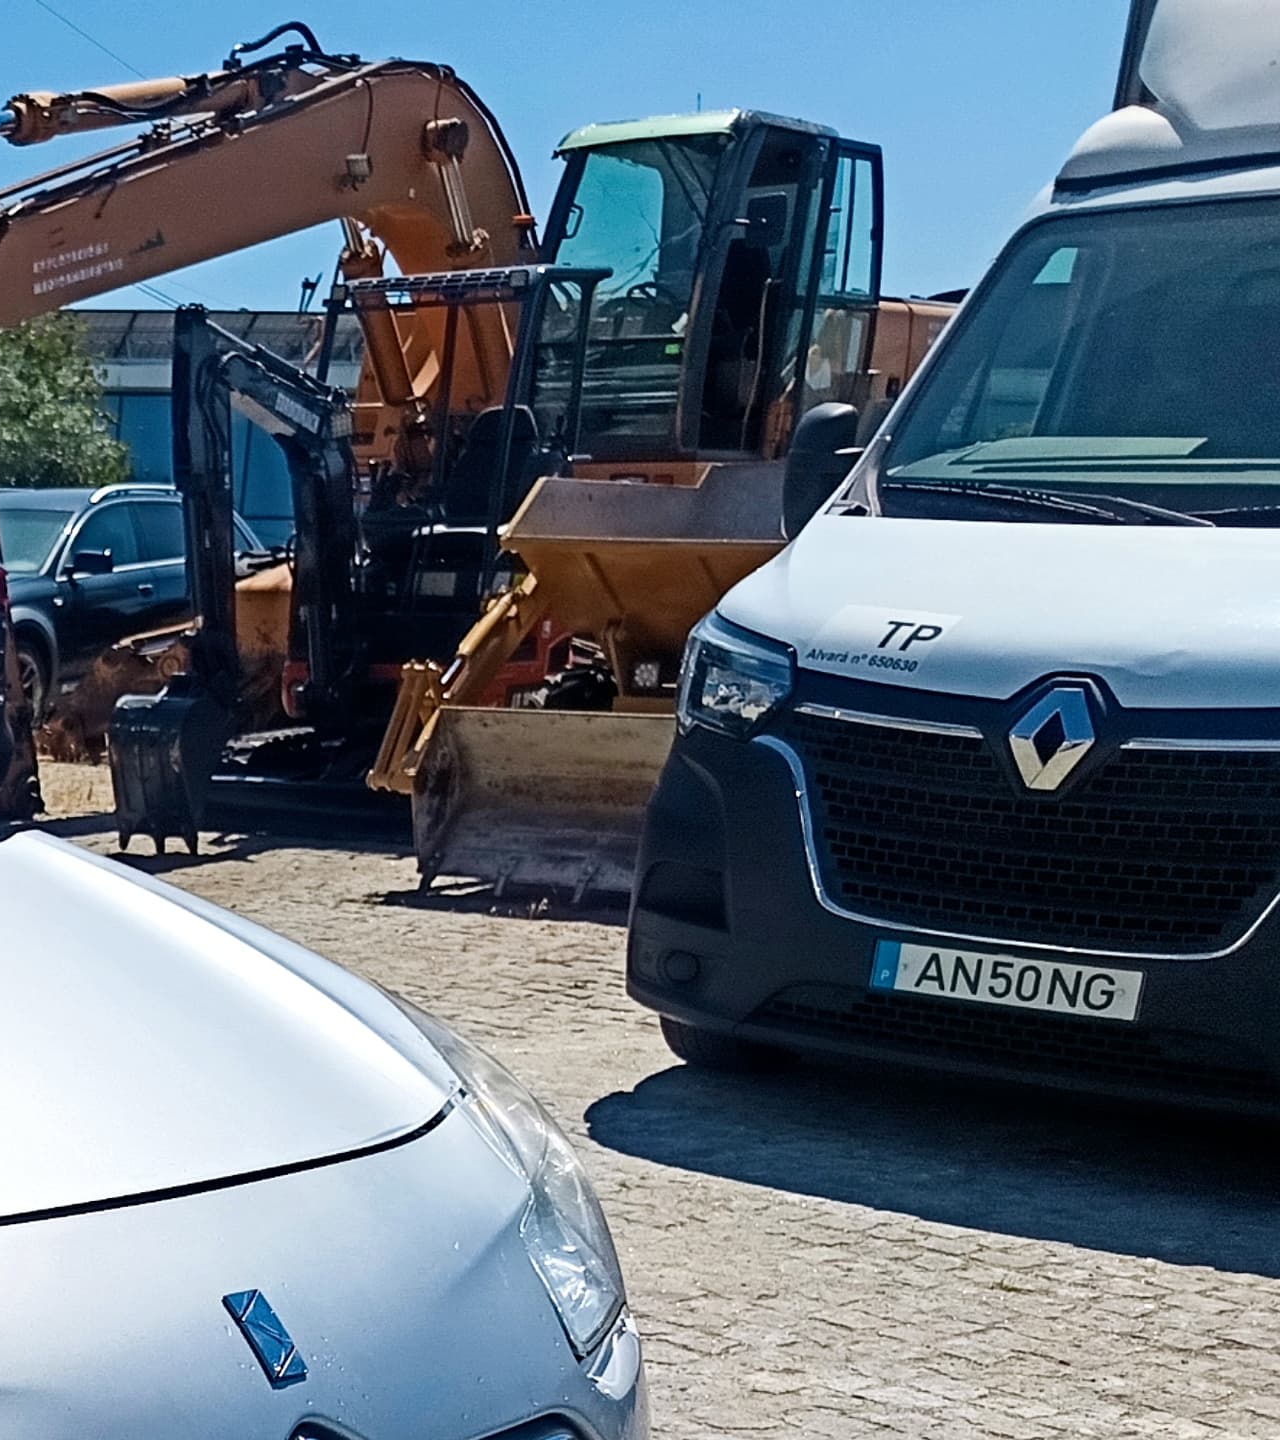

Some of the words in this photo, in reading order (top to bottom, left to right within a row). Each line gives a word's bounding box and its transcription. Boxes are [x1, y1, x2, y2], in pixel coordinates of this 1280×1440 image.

[877, 620, 943, 651] TP
[805, 648, 849, 664] Alvará
[868, 654, 919, 673] 650630
[914, 952, 1116, 1011] AN50NG
